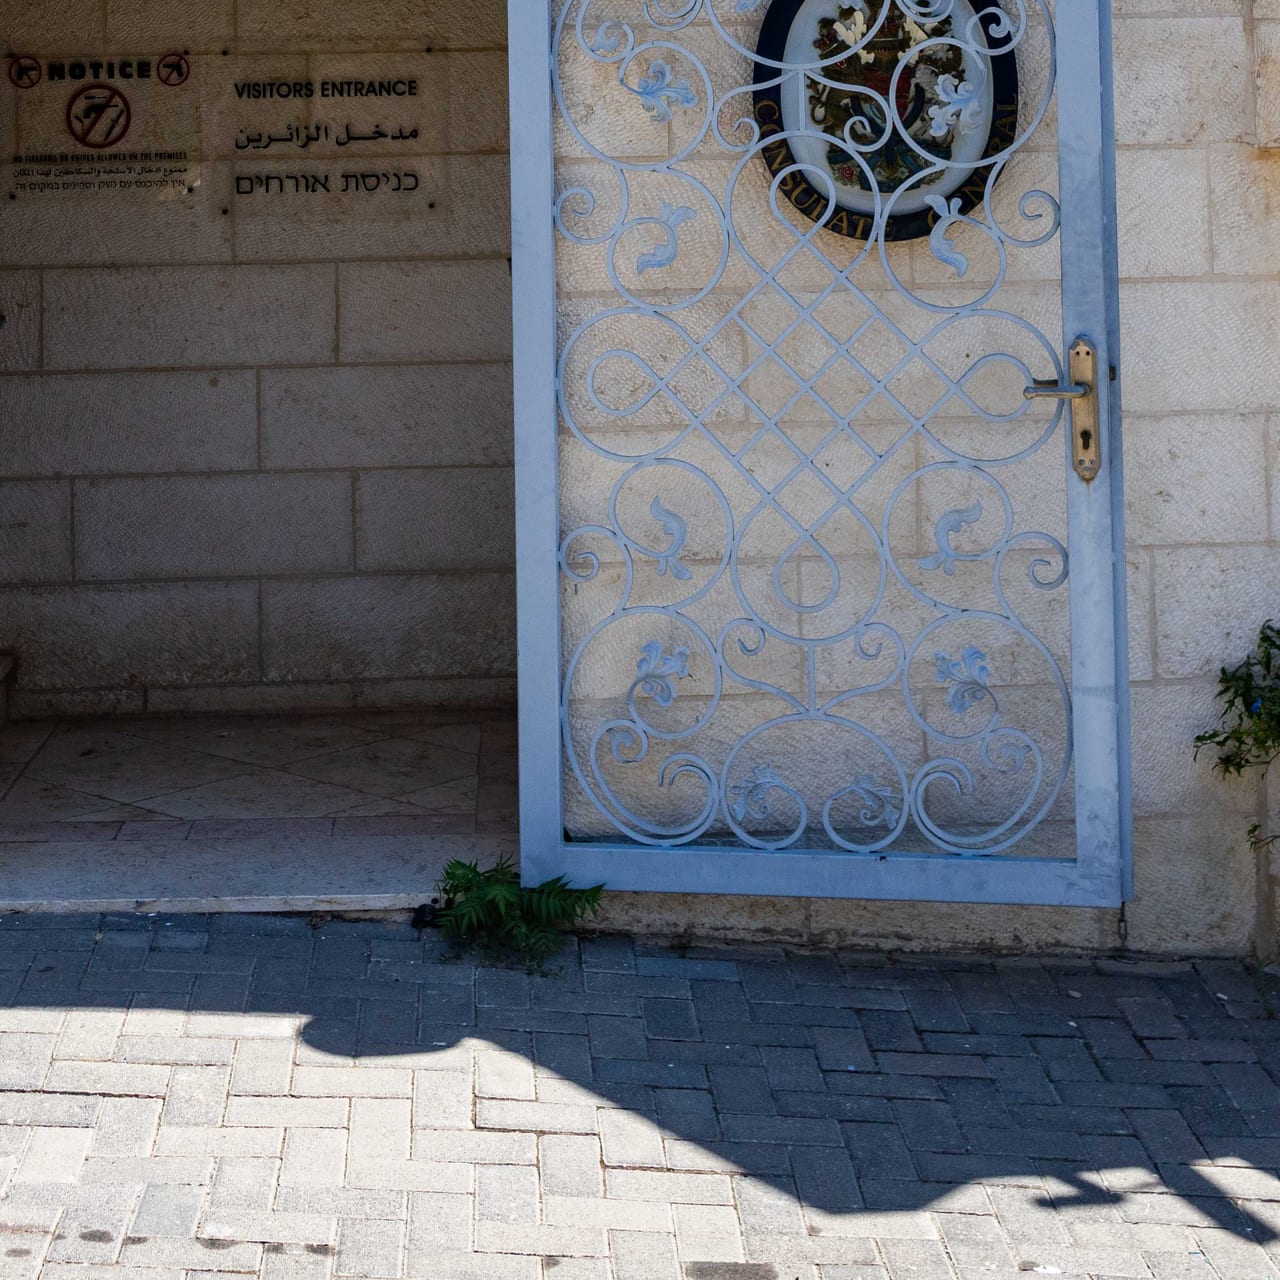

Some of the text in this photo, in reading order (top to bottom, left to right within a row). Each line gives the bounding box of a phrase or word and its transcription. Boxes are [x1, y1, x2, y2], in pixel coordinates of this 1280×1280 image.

[47, 60, 152, 82] NOTICE
[234, 79, 418, 100] VISITORS ENTRANCE
[234, 123, 420, 150] مدخل الزائرين
[96, 152, 126, 161] ALLOWED
[128, 152, 138, 161] ON
[140, 152, 151, 161] THE
[154, 151, 188, 161] PREMISES
[97, 180, 117, 190] נשק
[234, 171, 420, 195] כניסת אורחים
